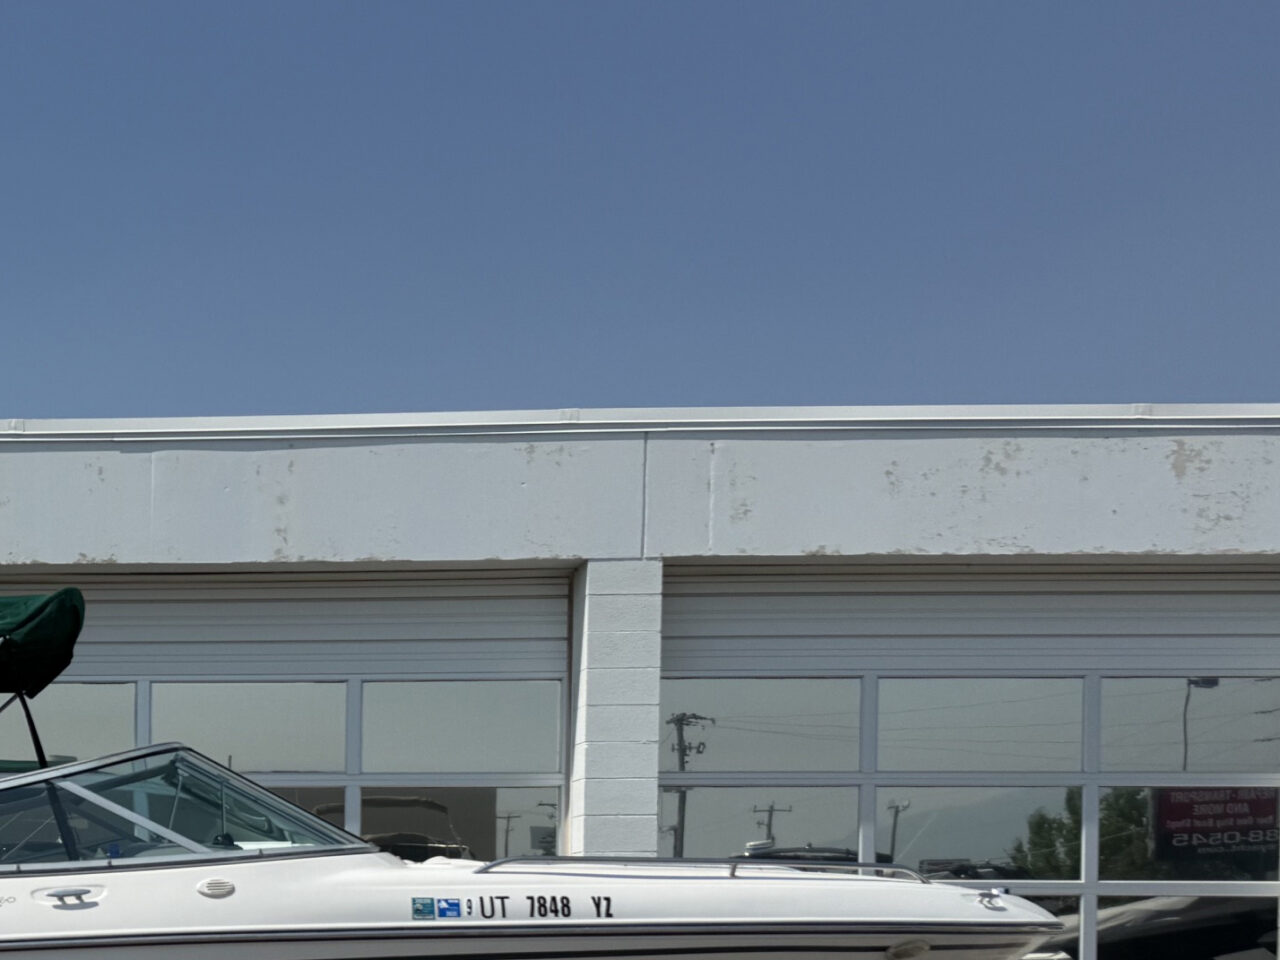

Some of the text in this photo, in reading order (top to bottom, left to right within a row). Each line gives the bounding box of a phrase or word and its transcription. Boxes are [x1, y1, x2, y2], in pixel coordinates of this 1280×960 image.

[479, 896, 510, 919] UT
[526, 896, 571, 918] 7848
[591, 896, 614, 918] YZ
